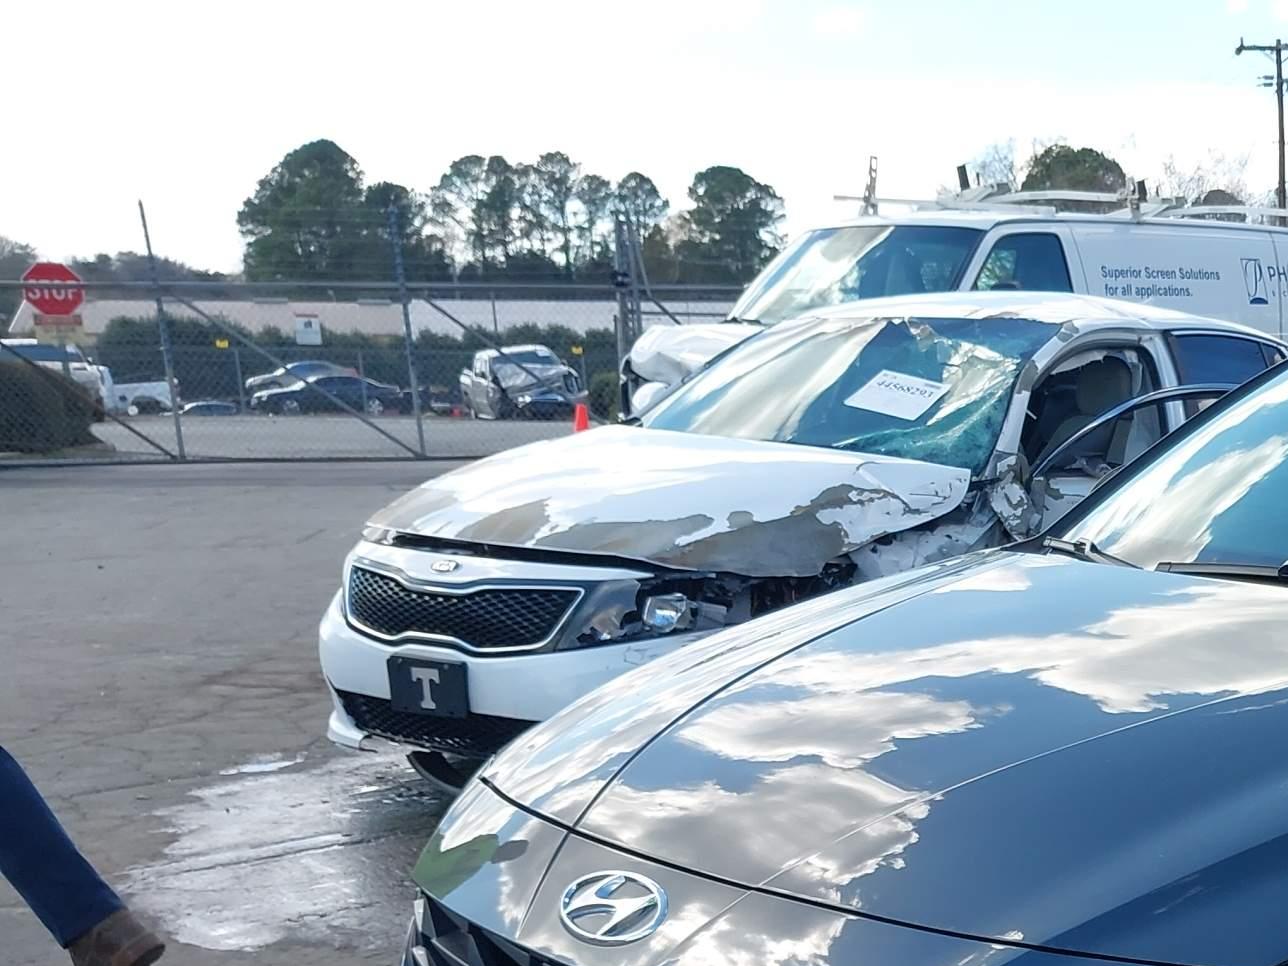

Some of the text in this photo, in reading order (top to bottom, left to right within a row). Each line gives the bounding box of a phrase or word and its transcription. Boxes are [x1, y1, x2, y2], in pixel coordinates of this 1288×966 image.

[1100, 265, 1221, 281] Superior Screen Solutions
[27, 279, 77, 301] STOP
[1104, 283, 1193, 299] for all applications.
[410, 667, 441, 710] T
